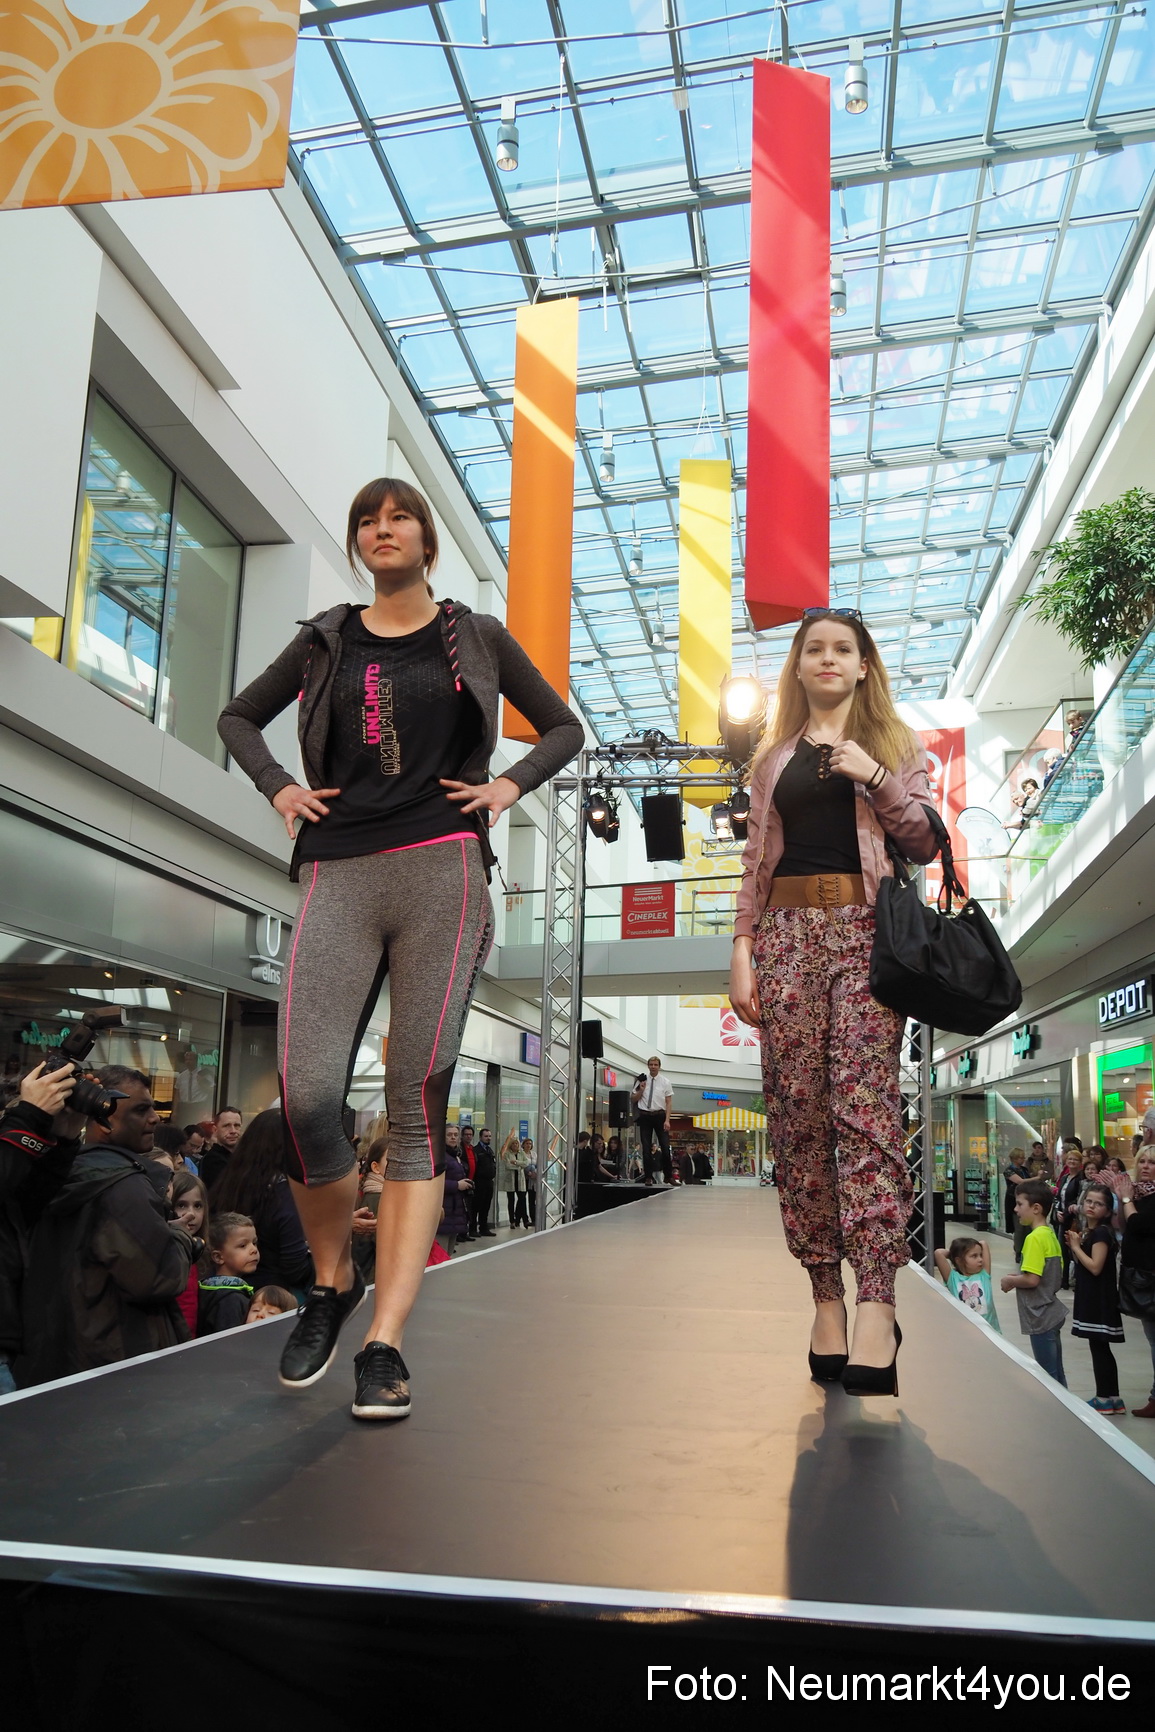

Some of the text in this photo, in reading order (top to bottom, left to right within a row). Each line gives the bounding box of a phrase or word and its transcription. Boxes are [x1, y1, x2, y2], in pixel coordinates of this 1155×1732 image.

[260, 914, 282, 957] U
[1098, 979, 1146, 1024] DEPOT
[20, 1135, 44, 1152] EOS
